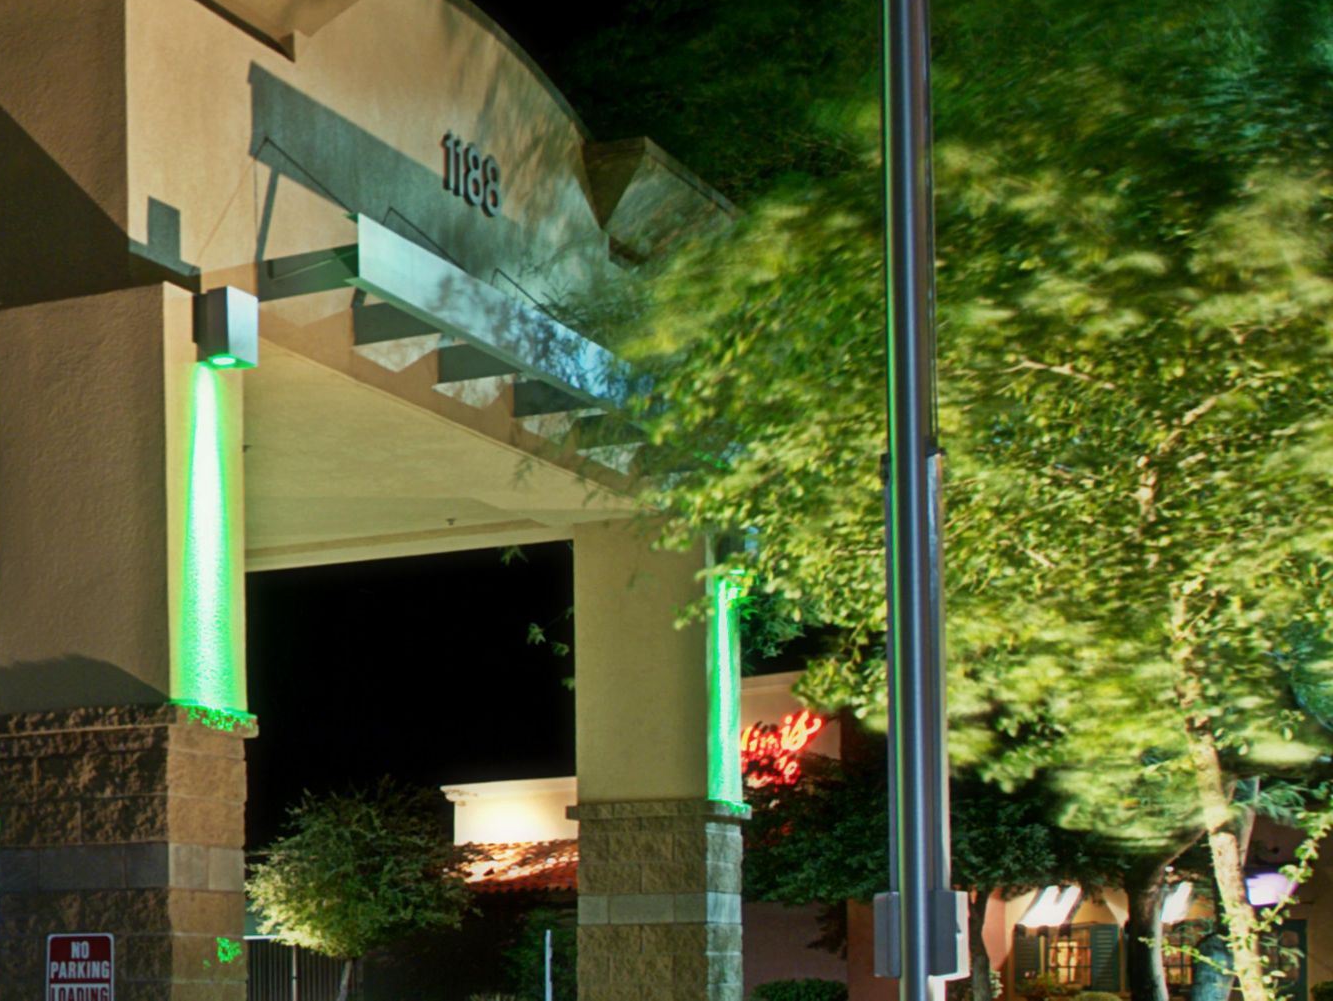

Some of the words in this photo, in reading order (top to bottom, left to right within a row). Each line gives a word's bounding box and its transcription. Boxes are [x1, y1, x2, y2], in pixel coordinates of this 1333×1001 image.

[440, 130, 501, 218] 1188
[70, 940, 90, 959] NO
[50, 960, 110, 979] PARKING
[50, 986, 110, 1001] LOADING
